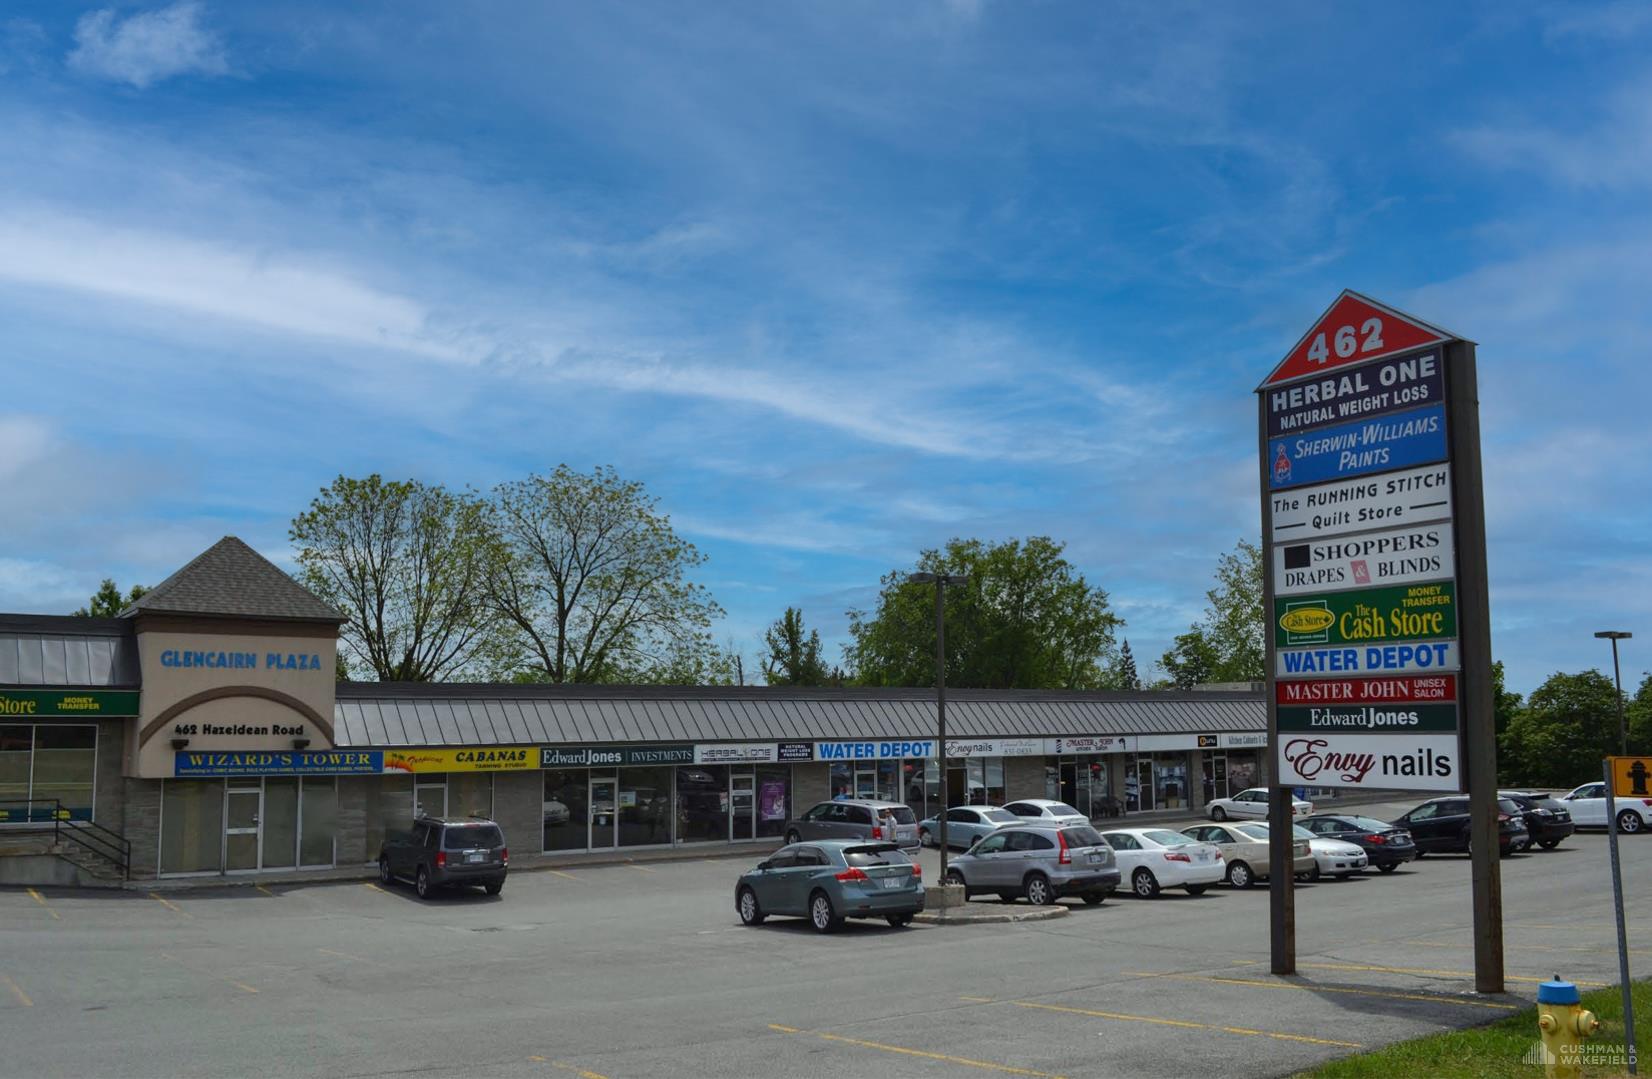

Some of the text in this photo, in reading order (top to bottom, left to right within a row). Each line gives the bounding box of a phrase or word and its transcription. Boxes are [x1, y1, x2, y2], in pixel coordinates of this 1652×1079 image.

[1307, 317, 1384, 364] 462
[1272, 355, 1436, 412] HERBAL ONE
[1280, 384, 1429, 430] NATURAL WEIGHT LOSS
[1338, 448, 1390, 471] PAINTS
[1274, 472, 1447, 513] The RUNNING STITCH
[1312, 506, 1403, 529] Quilt Store
[1313, 531, 1440, 562] SHOPPERS
[1285, 567, 1345, 588] DRAPES
[1378, 556, 1441, 578] BLINDS
[1402, 595, 1450, 607] TRANSFER
[1408, 586, 1441, 597] MONEY
[1356, 604, 1371, 617] The
[1340, 608, 1443, 640] Cash Store
[160, 650, 321, 670] GLENCAIRN PLAZA
[1283, 644, 1449, 673] WATER DEPOT
[1286, 681, 1409, 700] MASTER JOHN
[1414, 679, 1446, 689] UNISEX
[1414, 688, 1444, 698] SALON
[175, 724, 198, 736] 462
[272, 724, 304, 736] Road
[456, 750, 527, 763] CABANAS
[631, 750, 693, 762] INVESTMENTS
[819, 742, 932, 759] WATER DEPOT
[973, 743, 993, 752] nails
[190, 753, 371, 766] WIZARD'S TOWER
[1285, 739, 1452, 783] Envy nails
